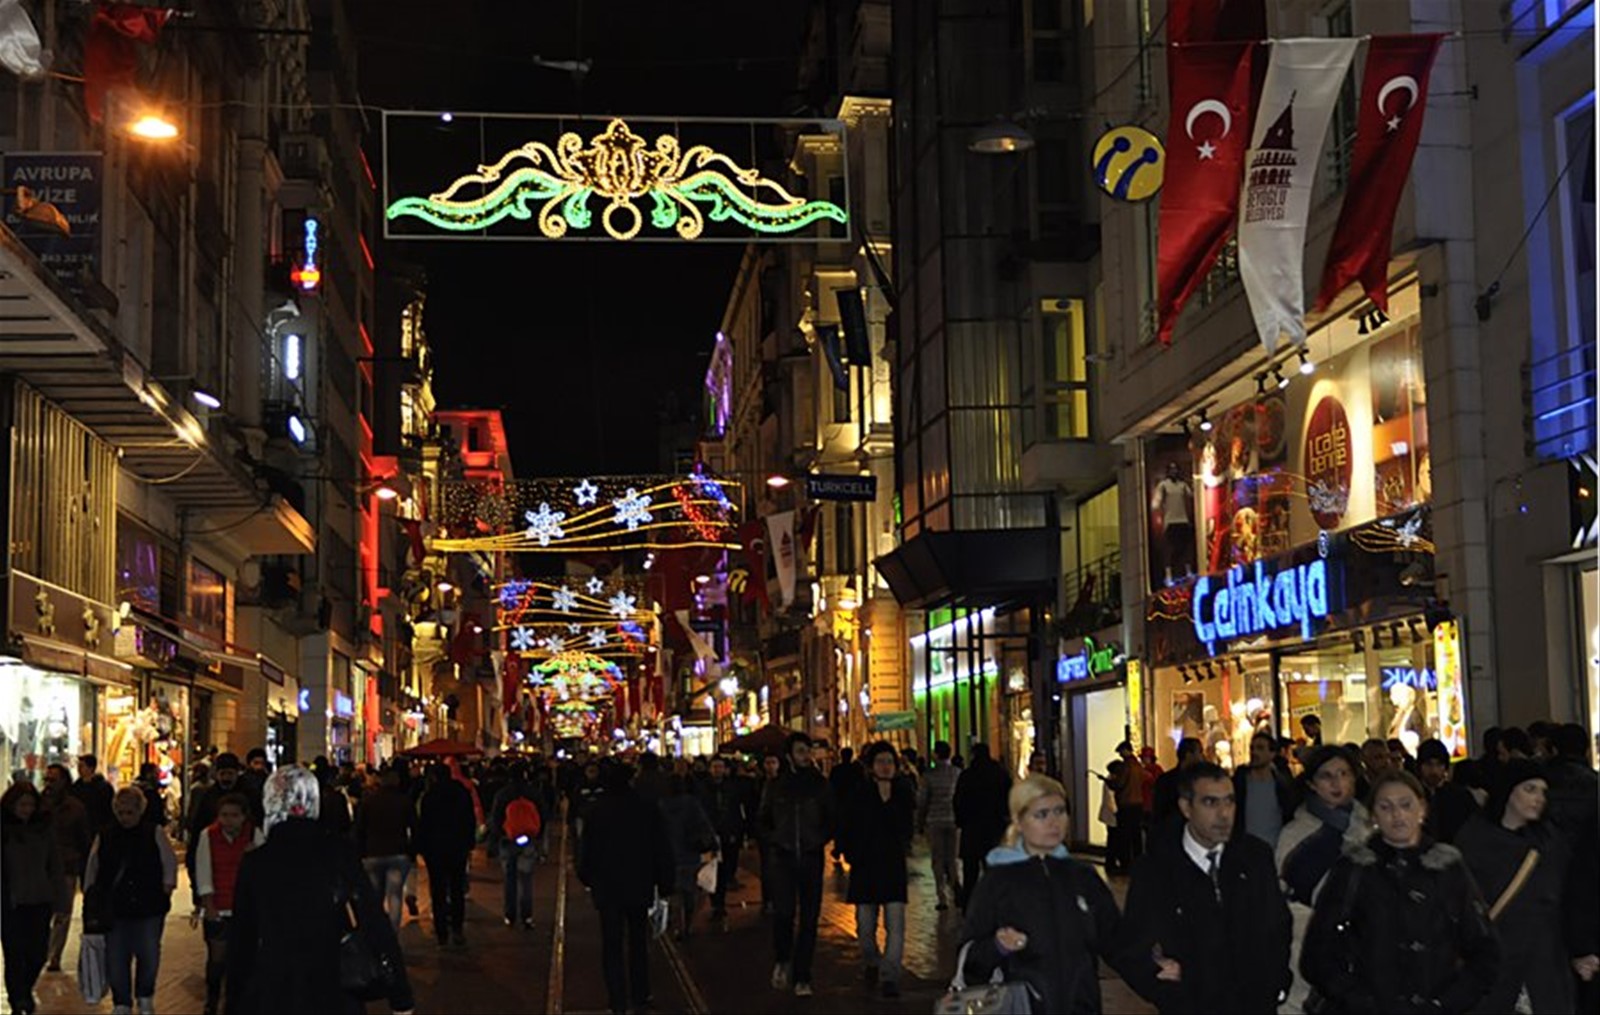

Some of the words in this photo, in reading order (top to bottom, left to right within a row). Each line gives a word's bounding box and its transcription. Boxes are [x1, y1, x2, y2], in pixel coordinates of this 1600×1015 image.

[13, 166, 93, 180] AVRUPA
[811, 480, 873, 495] TURKCELL
[1193, 559, 1328, 657] Çetinkaya
